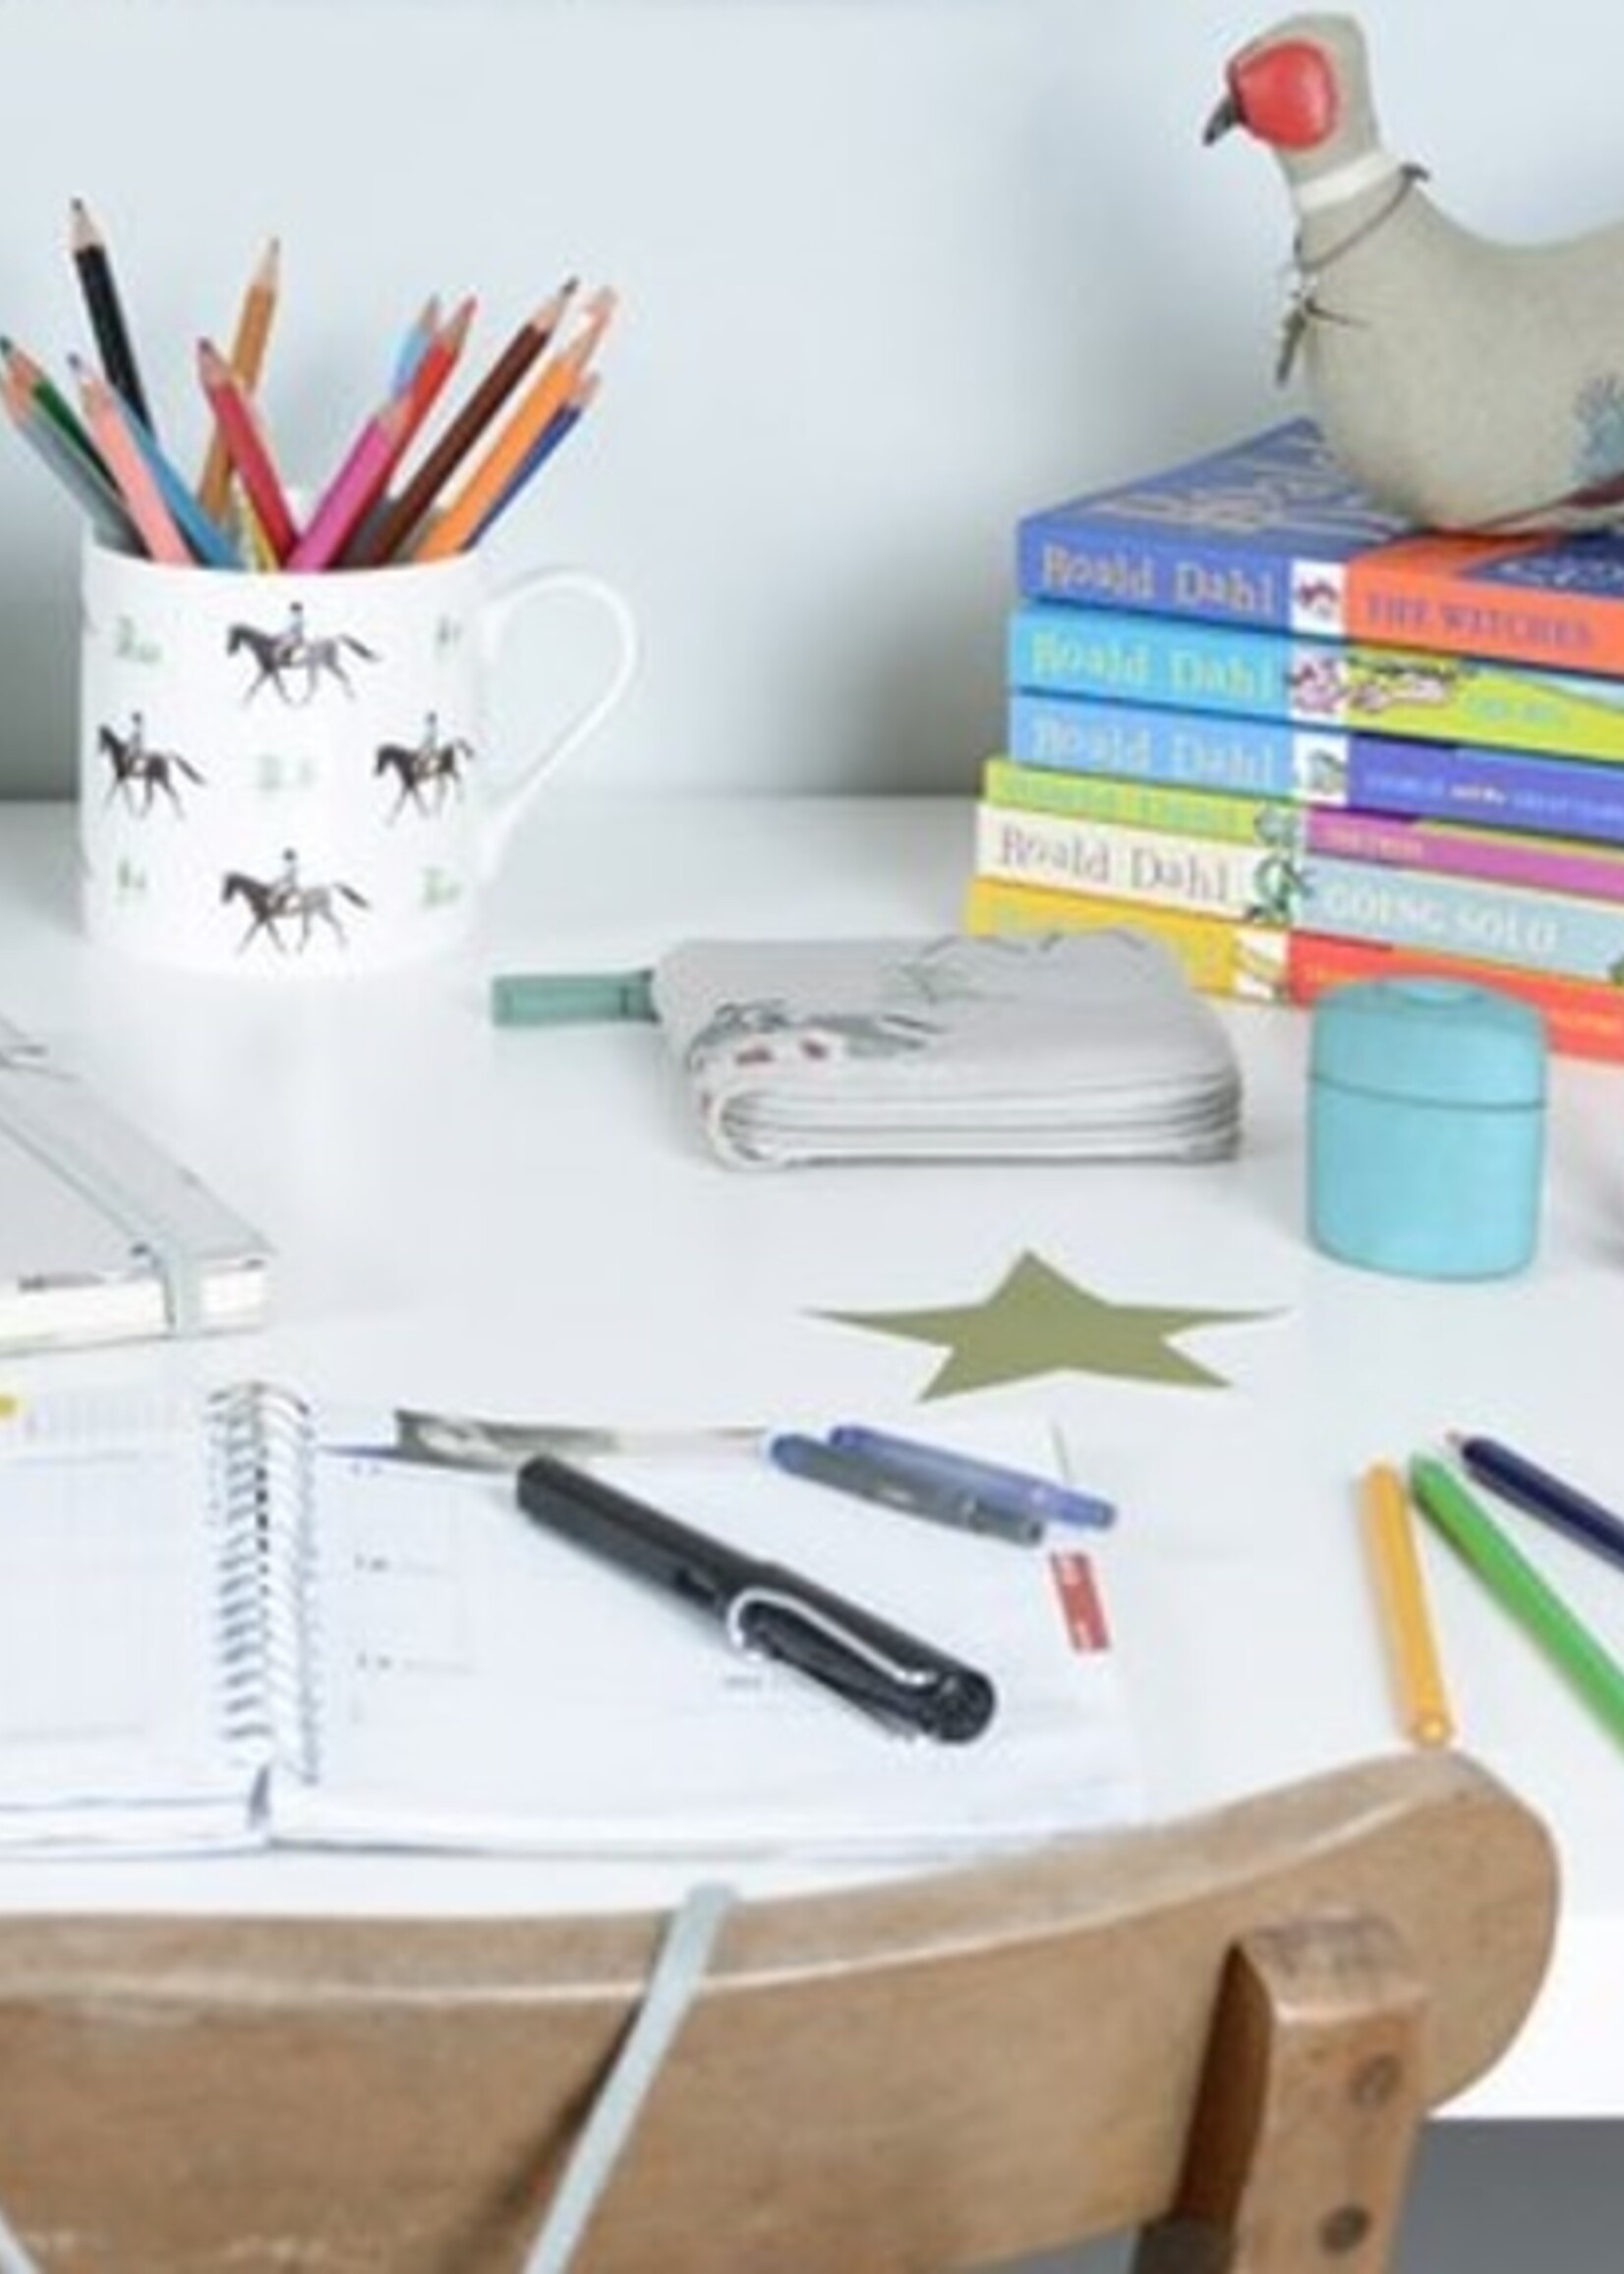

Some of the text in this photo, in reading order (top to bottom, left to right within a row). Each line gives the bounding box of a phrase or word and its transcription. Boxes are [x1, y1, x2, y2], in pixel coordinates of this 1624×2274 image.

[1042, 544, 1275, 614] Roald Dahl
[1441, 605, 1594, 649] WITCHES
[1031, 629, 1273, 702] Roald Dahl
[1033, 718, 1275, 789] Roald Dahl
[1001, 824, 1228, 901] Roald Dahl
